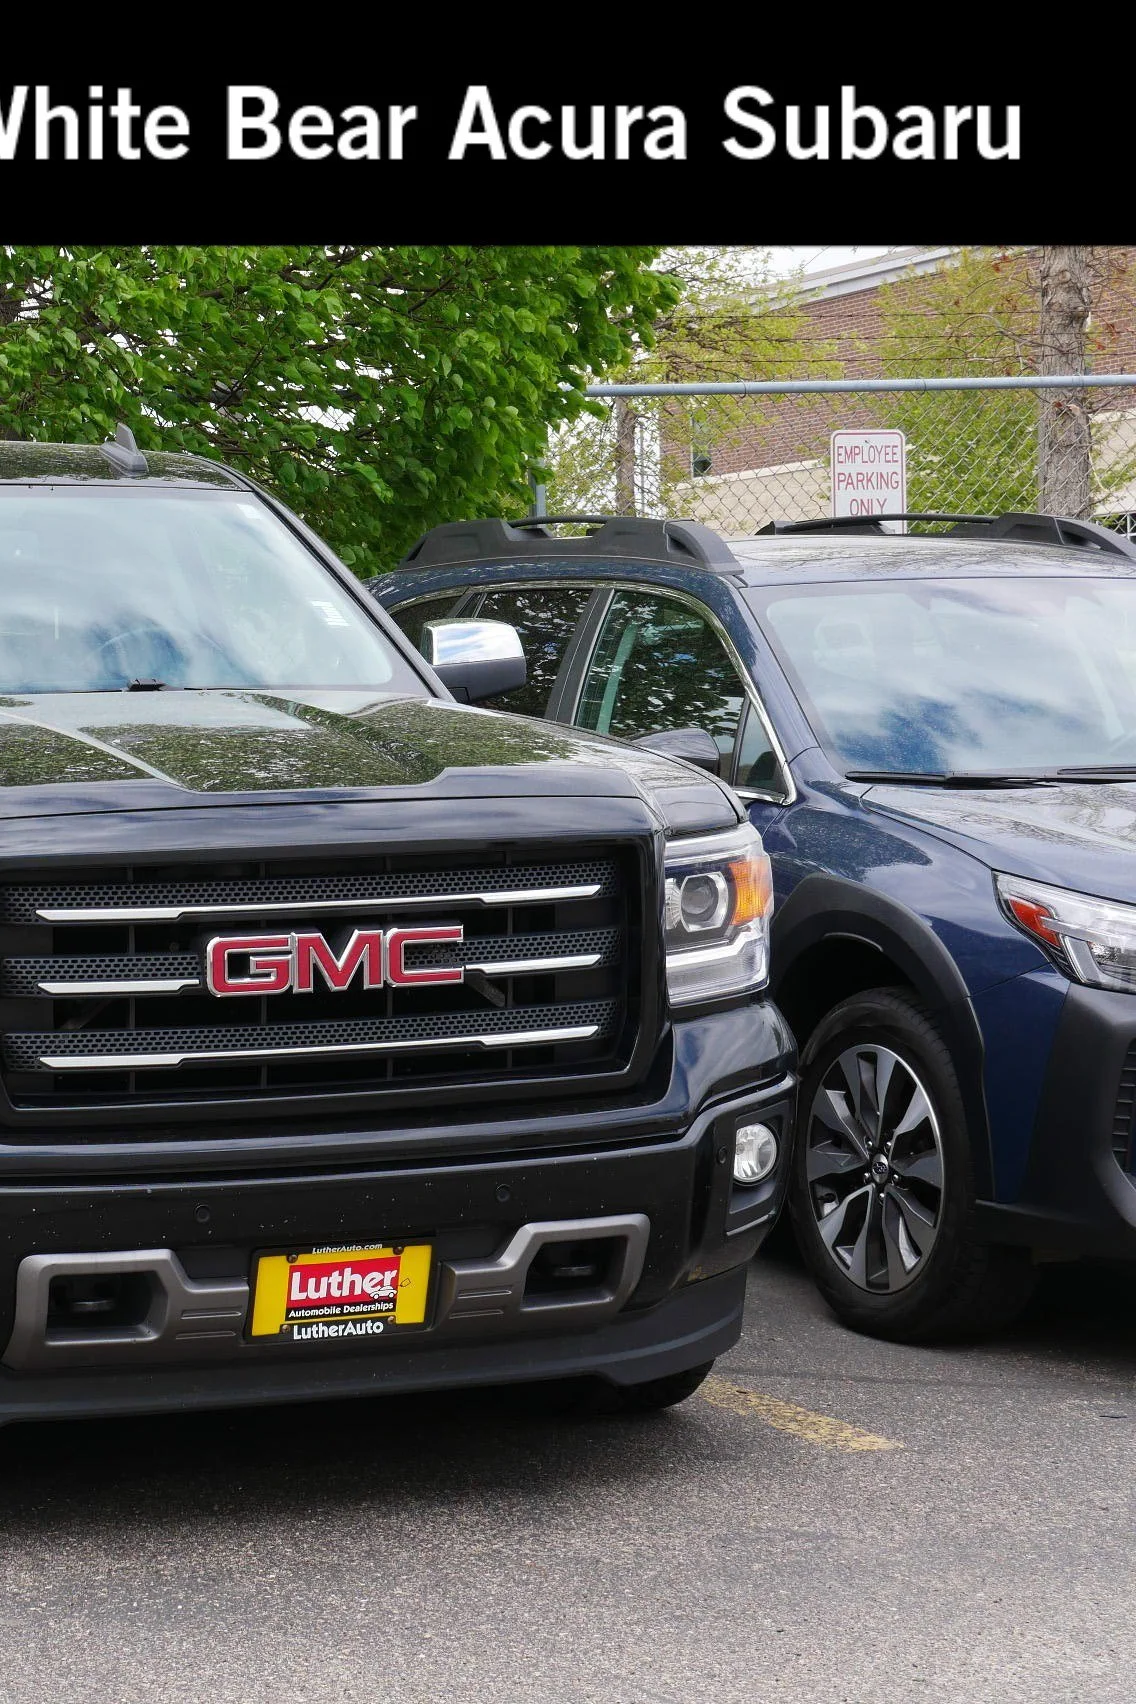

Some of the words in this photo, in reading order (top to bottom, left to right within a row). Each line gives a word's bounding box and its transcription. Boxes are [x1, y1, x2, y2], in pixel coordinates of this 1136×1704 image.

[837, 445, 899, 464] EMPLOYEE
[837, 471, 900, 491] PARKING
[206, 925, 464, 998] GMC
[311, 1243, 383, 1255] LutherAuto.com
[290, 1267, 397, 1301] Luther
[288, 1304, 341, 1319] Automobile
[343, 1302, 394, 1314] Dealerships
[293, 1320, 384, 1340] LutherAuto
